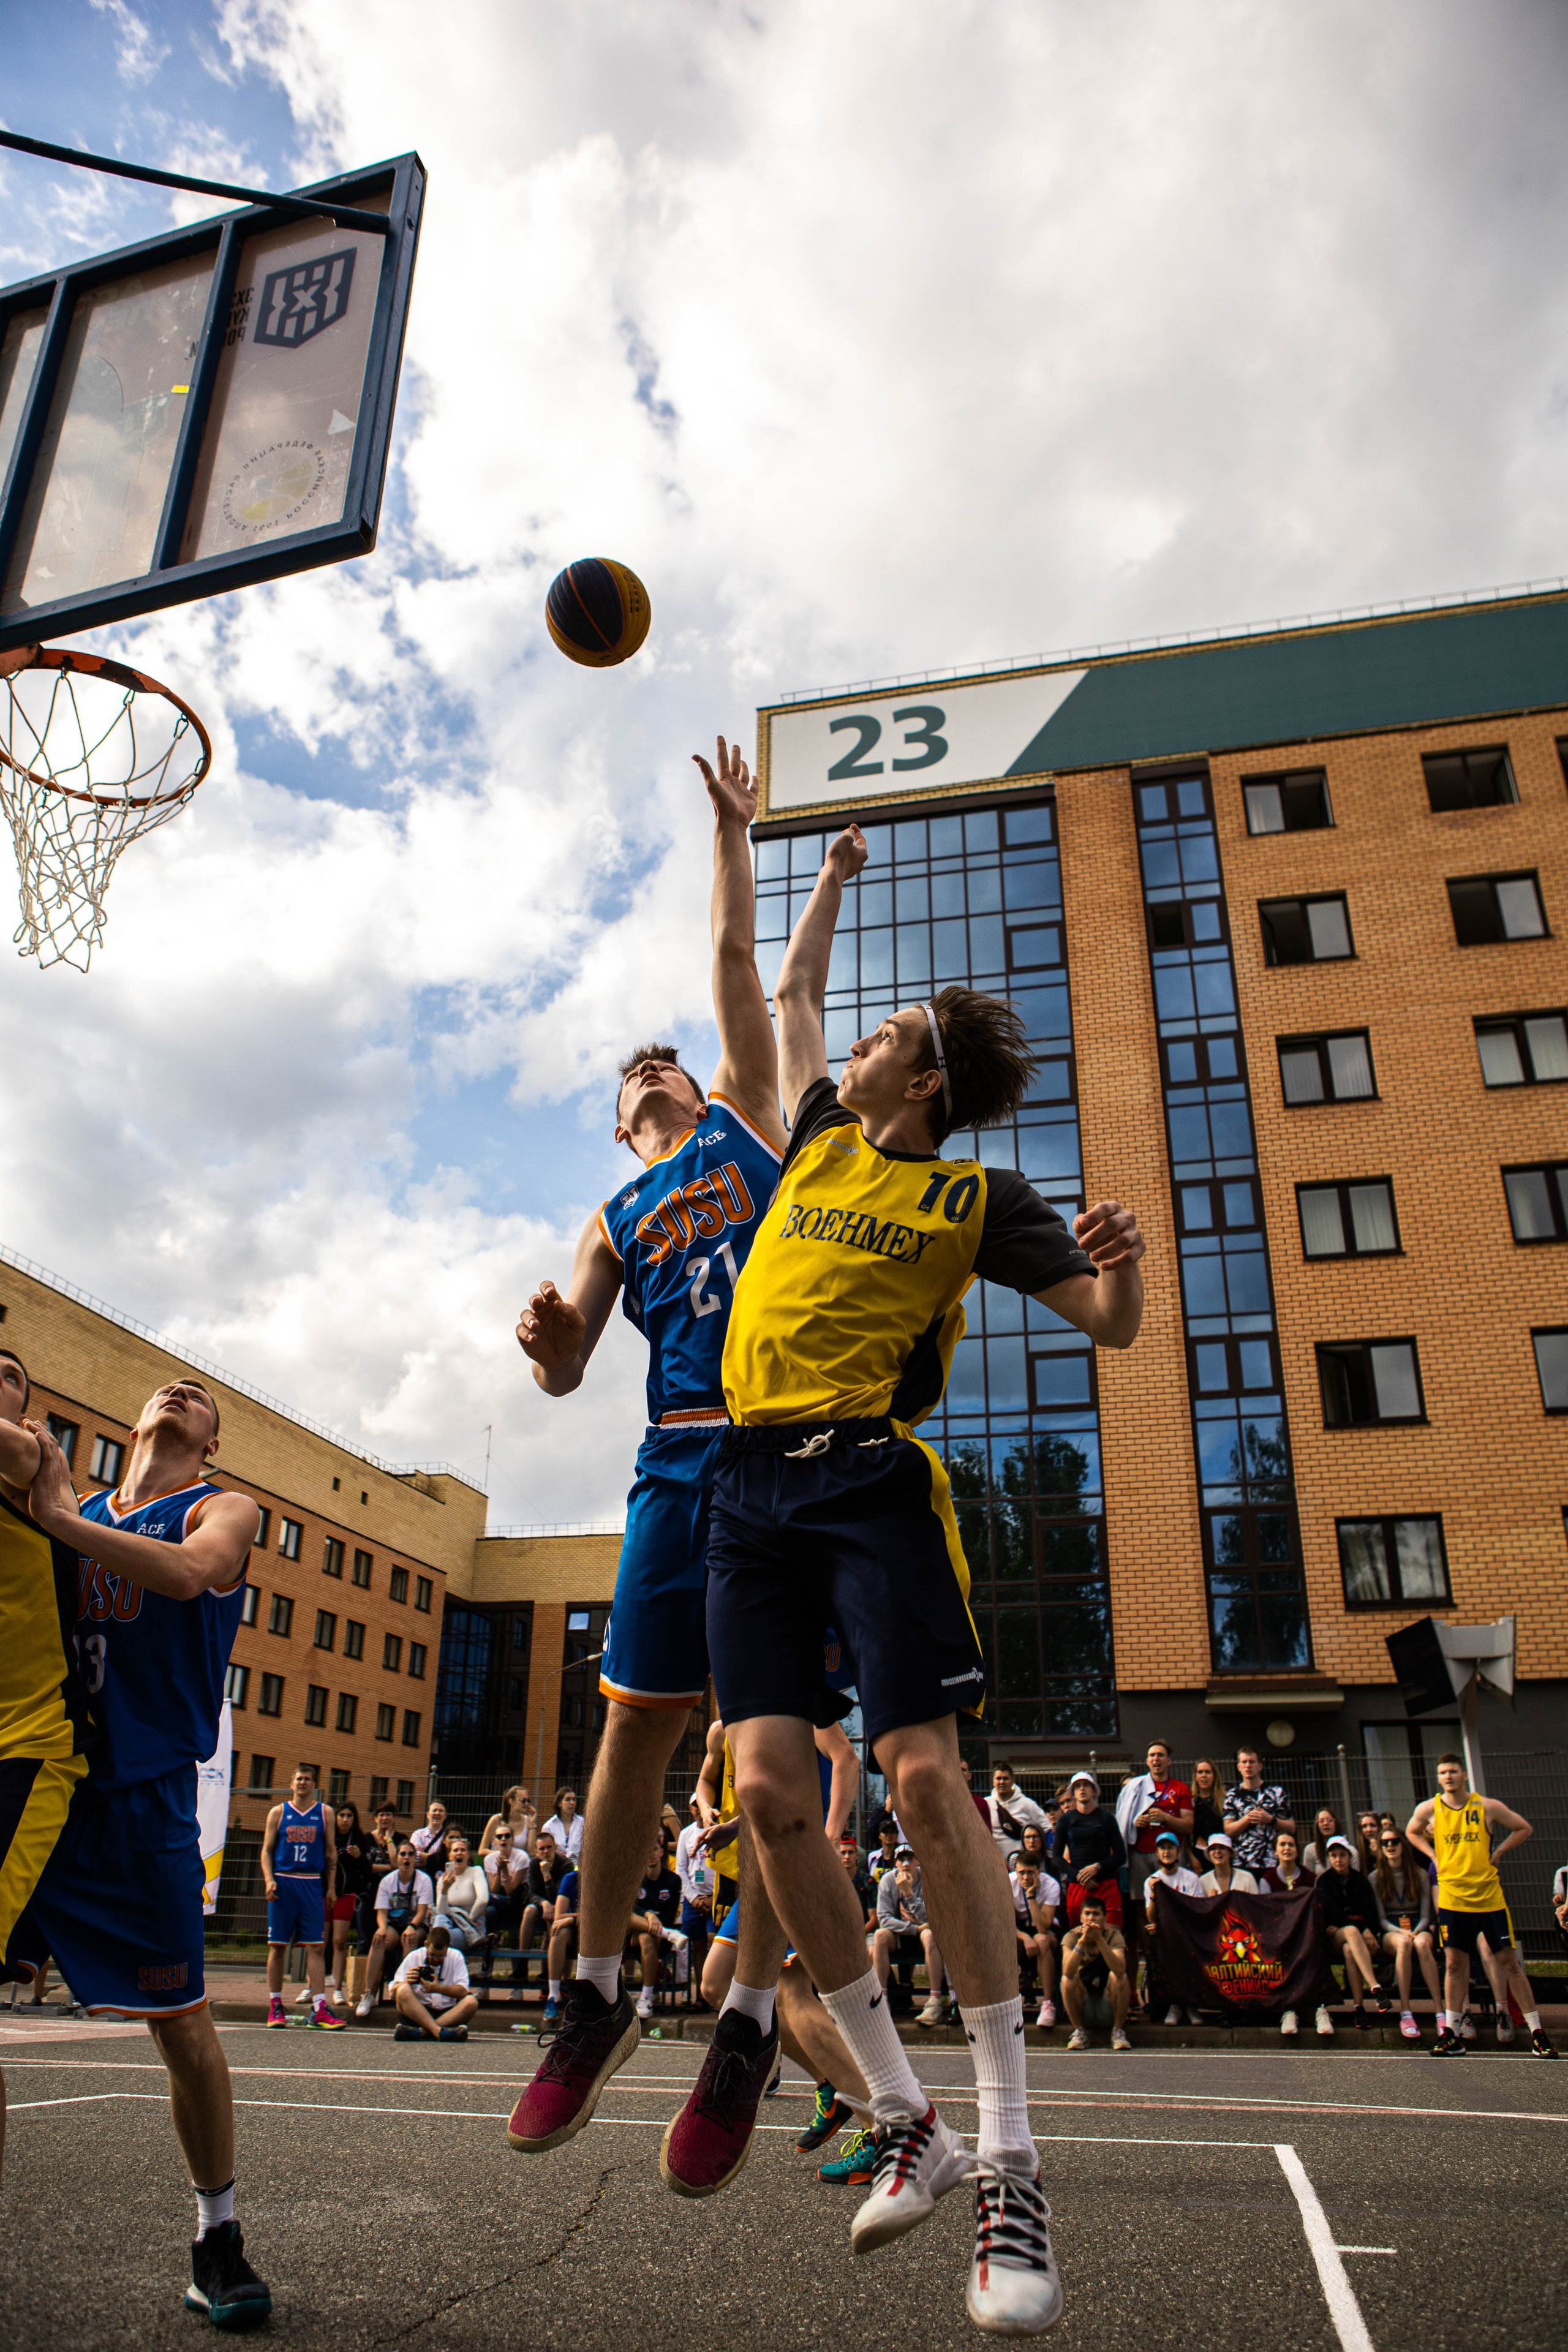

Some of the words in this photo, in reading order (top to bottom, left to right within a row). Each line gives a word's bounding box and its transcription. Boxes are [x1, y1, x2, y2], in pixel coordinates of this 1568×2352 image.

[827, 705, 949, 781] 23
[698, 1130, 725, 1148] ACE
[635, 1161, 755, 1267] SUSU
[918, 1171, 979, 1224] 10
[780, 1204, 935, 1264] BOEHMEX
[686, 1242, 739, 1319] 21
[137, 1523, 166, 1534] ACE
[73, 1634, 107, 1694] 3
[286, 1826, 316, 1843] SUSU
[1466, 1810, 1479, 1825] 14
[294, 1845, 307, 1862] 12
[138, 1962, 187, 1991] SUSU
